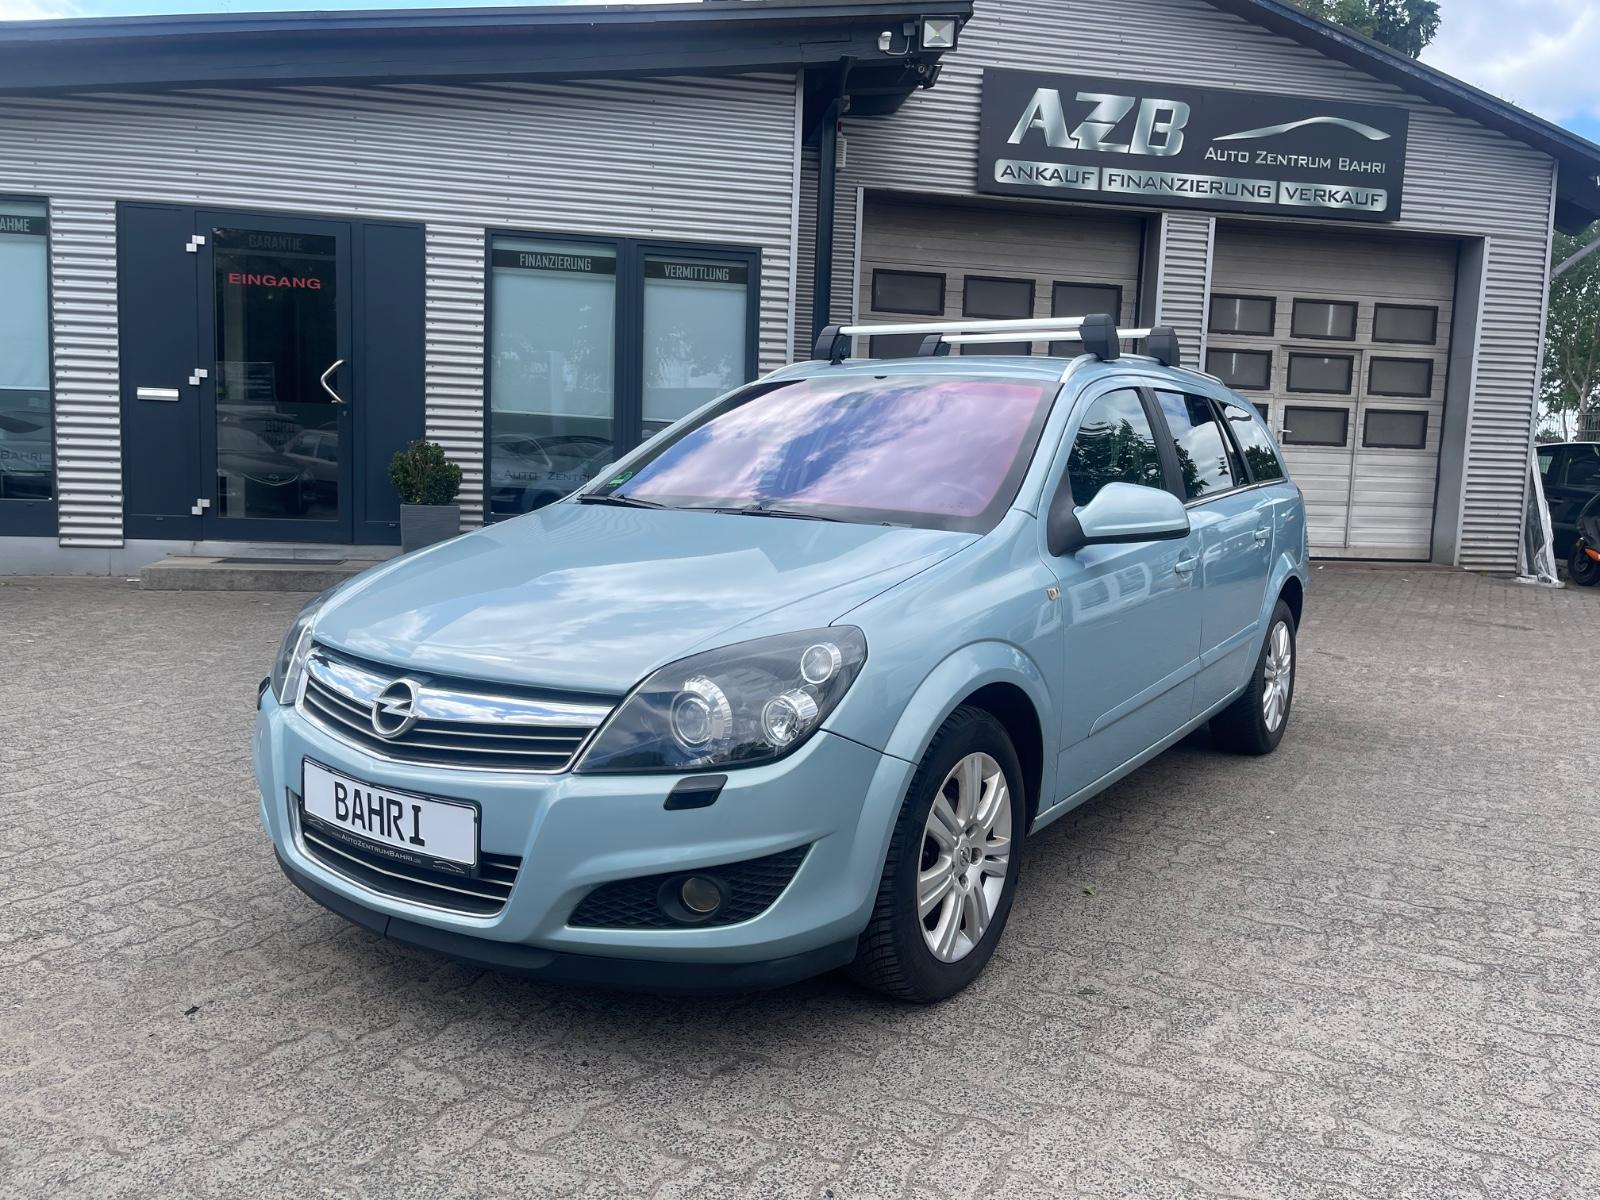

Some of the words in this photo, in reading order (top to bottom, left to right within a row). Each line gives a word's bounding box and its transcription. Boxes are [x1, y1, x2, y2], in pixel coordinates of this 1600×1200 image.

[1006, 87, 1191, 157] AZB
[1204, 146, 1249, 164] AUTO
[1255, 150, 1331, 169] ZENTRUM
[1338, 157, 1386, 174] BAHRI
[1000, 164, 1096, 185] ANKAUF
[1107, 172, 1272, 199] FINANZIERUNG
[1285, 187, 1384, 208] VERKAUF
[248, 234, 303, 251] GARANTIE
[519, 253, 592, 271] FINANZIERUNG
[664, 264, 730, 281] VERMITTLUNG
[228, 272, 321, 289] EINGANG
[334, 781, 426, 847] BAHRI
